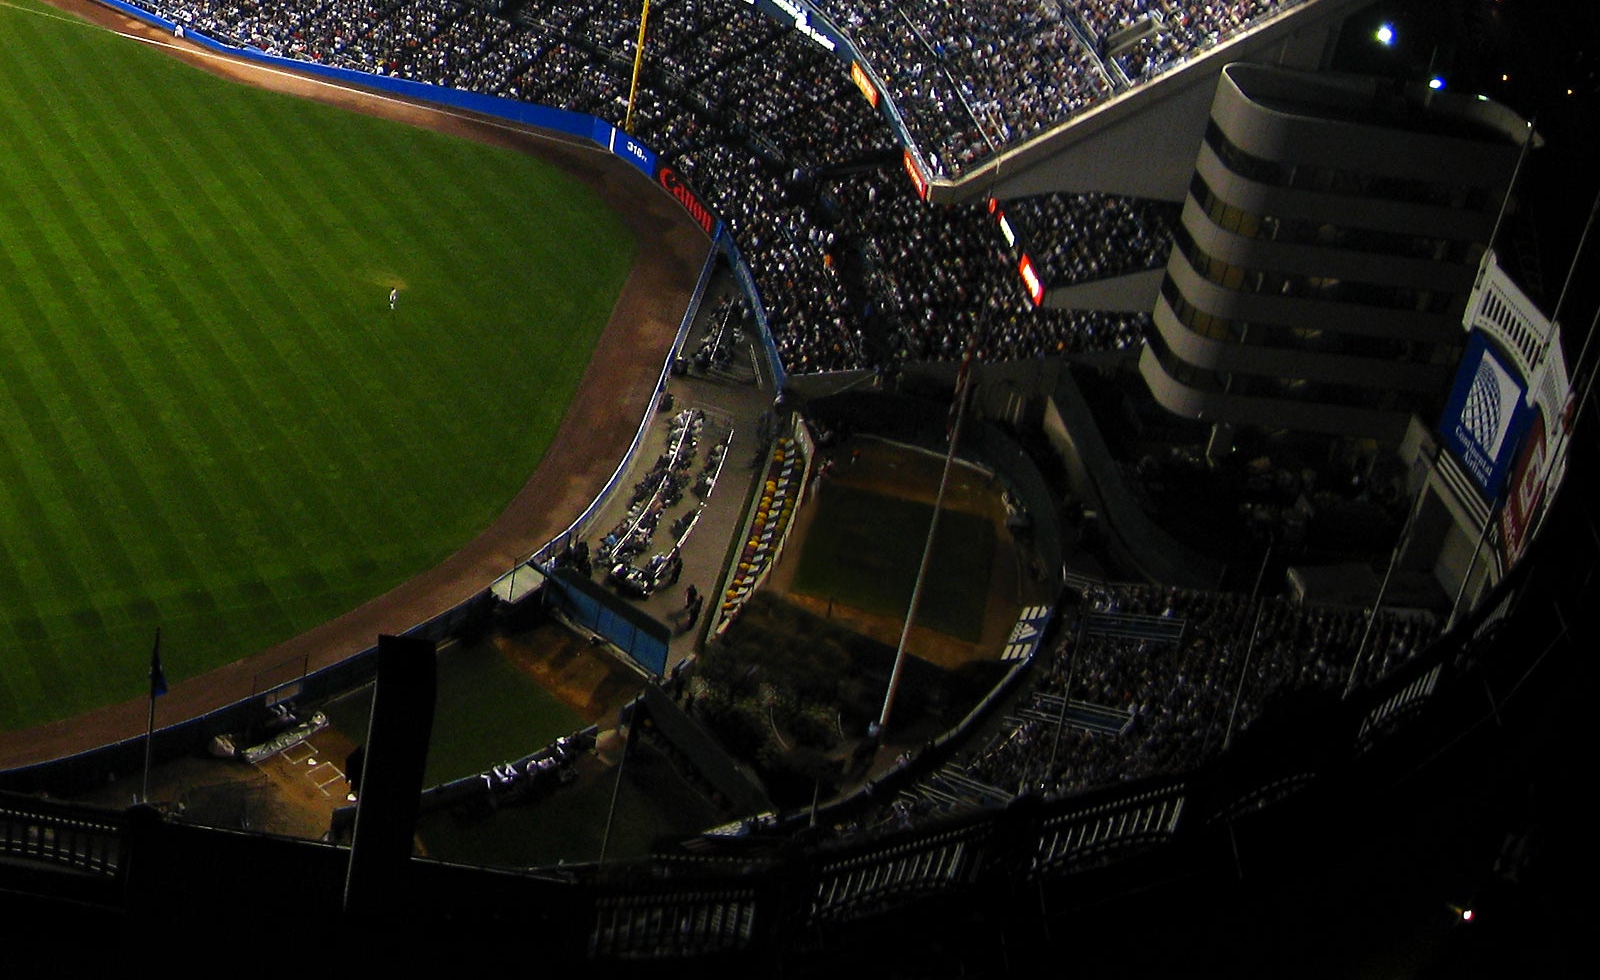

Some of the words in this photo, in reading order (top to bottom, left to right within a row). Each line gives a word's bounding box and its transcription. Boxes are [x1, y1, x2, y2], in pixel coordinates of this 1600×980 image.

[659, 167, 713, 234] Canon
[1455, 424, 1493, 476] Continental
[1462, 449, 1489, 488] Airlines
